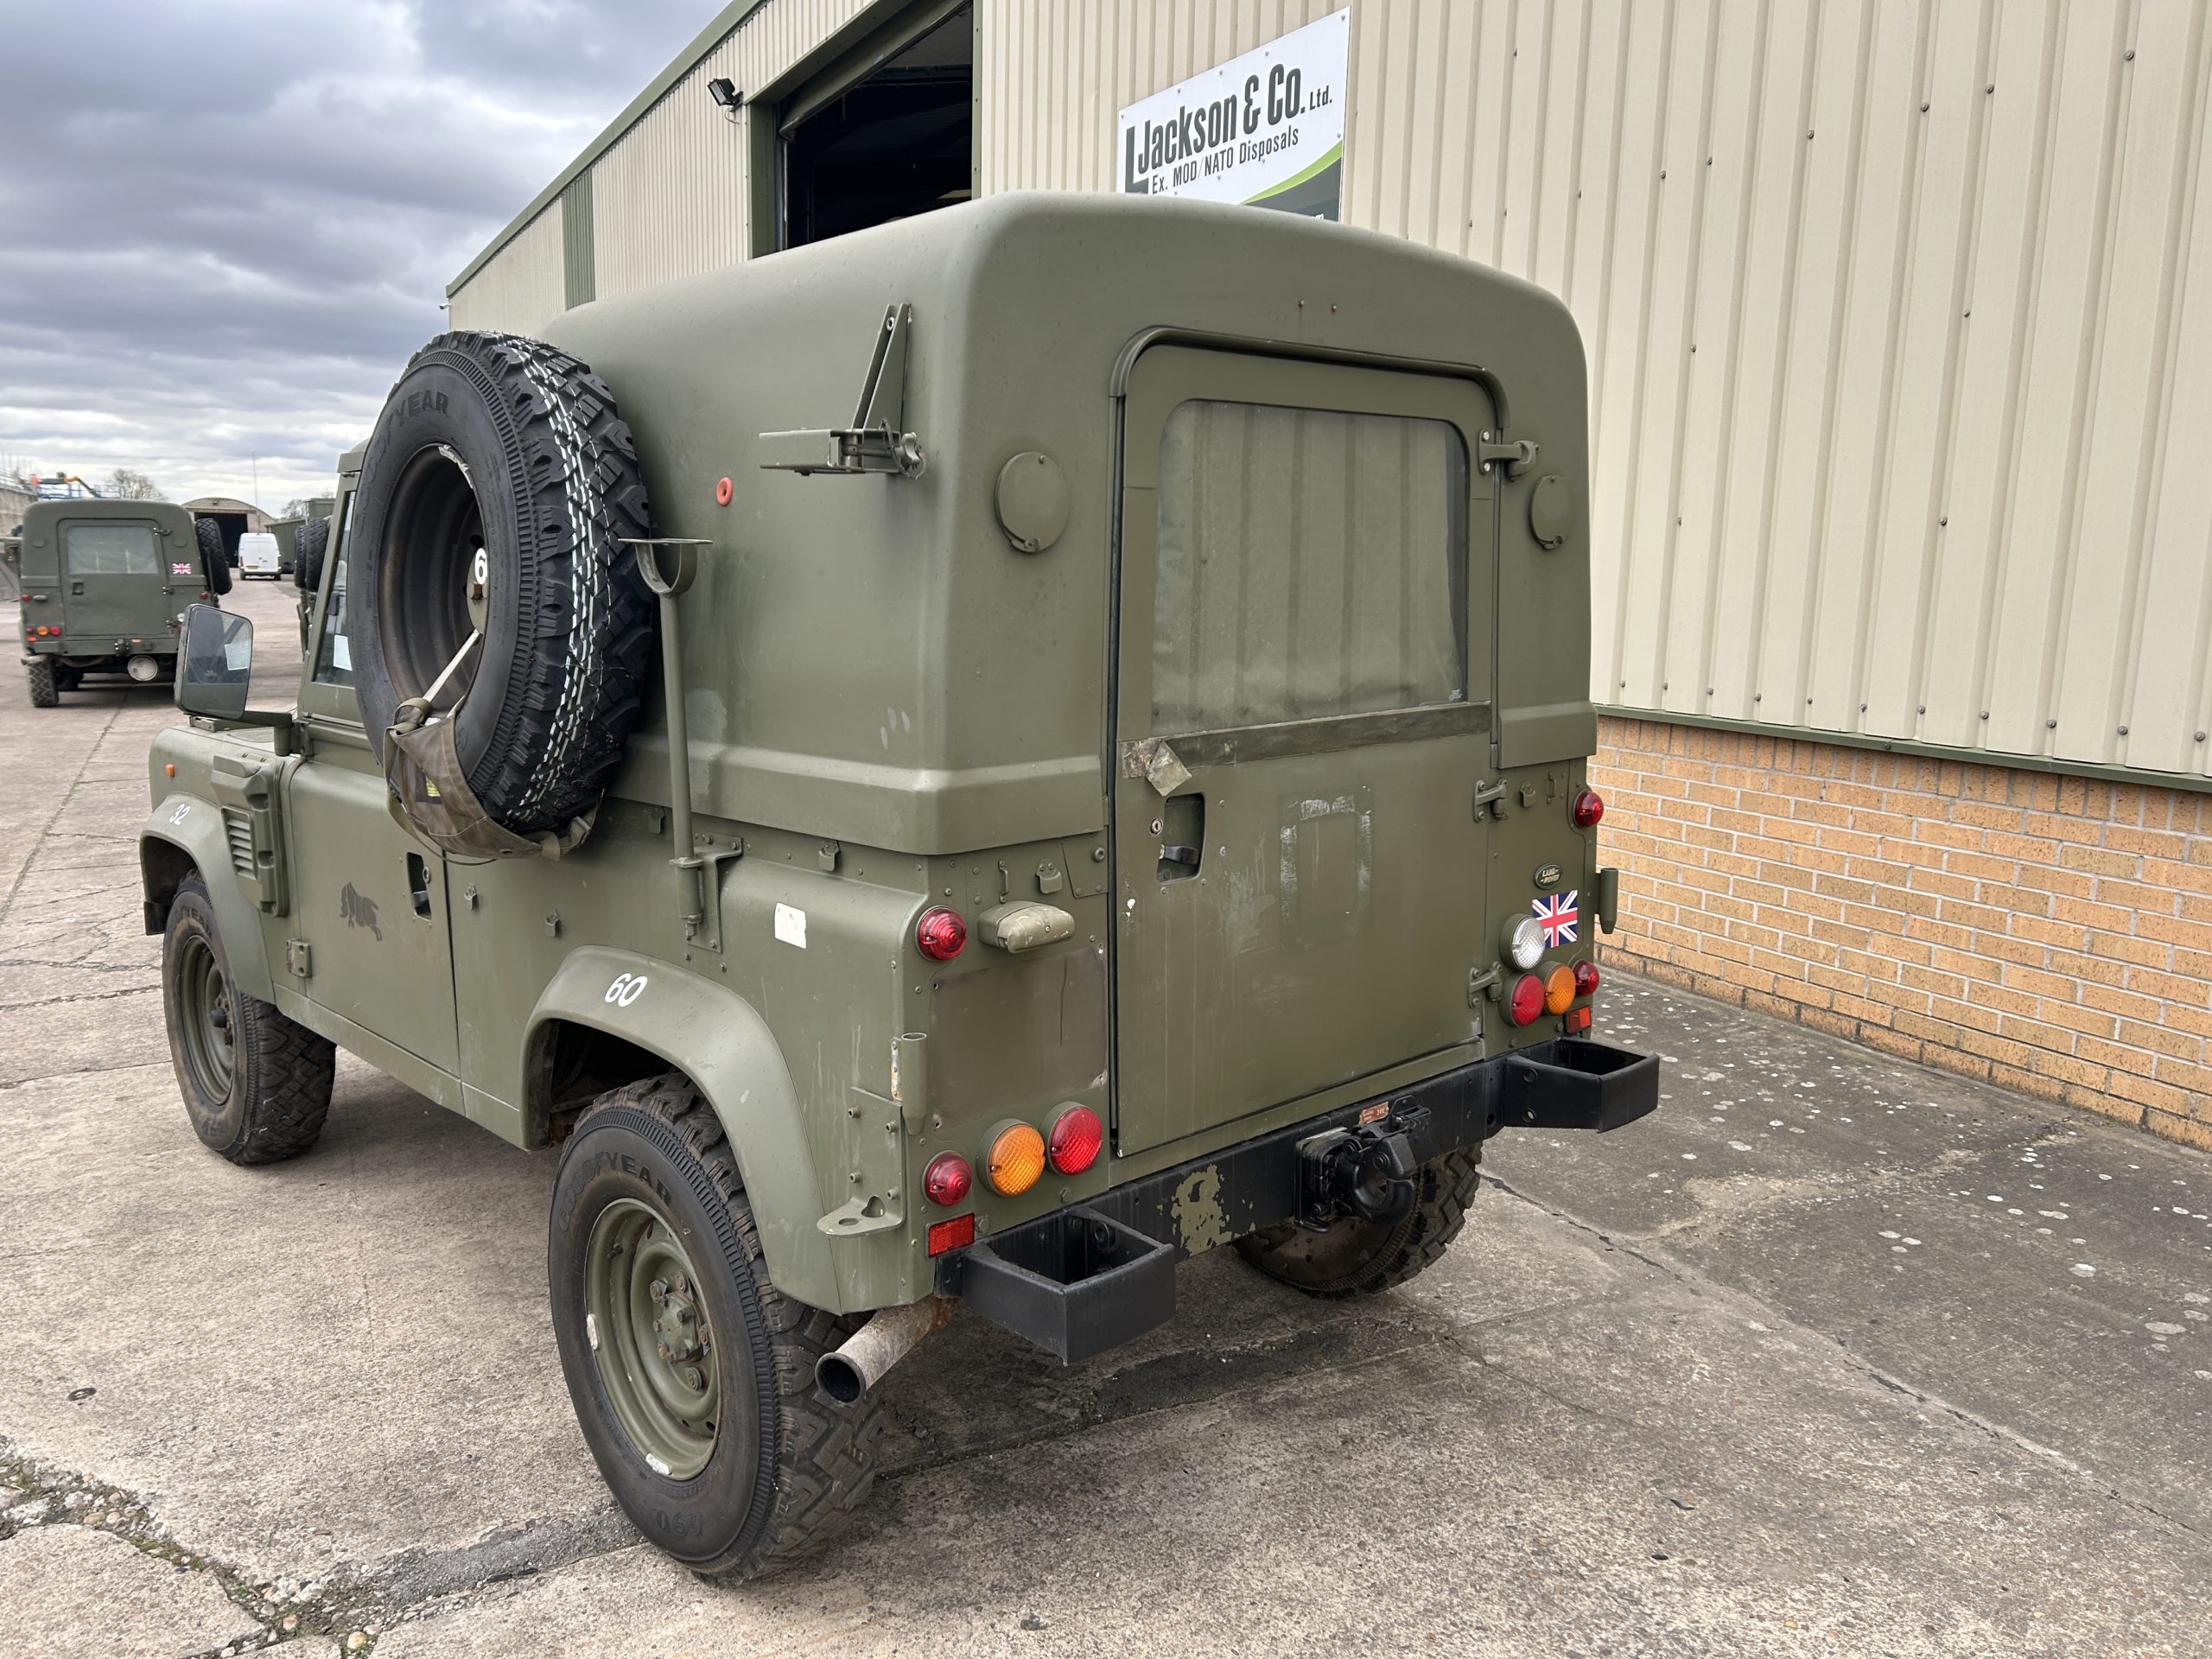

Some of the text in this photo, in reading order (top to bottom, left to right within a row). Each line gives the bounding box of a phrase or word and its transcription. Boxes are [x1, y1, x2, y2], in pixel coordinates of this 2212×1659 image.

[1137, 93, 1237, 175] Jackson
[1243, 74, 1262, 135] &
[1267, 63, 1306, 126] Co.
[1309, 85, 1332, 111] Ltd.
[1152, 174, 1168, 194] Ex.
[1239, 124, 1299, 165] Disposals
[474, 547, 488, 585] 6
[168, 803, 191, 826] 32
[604, 972, 648, 1007] 60
